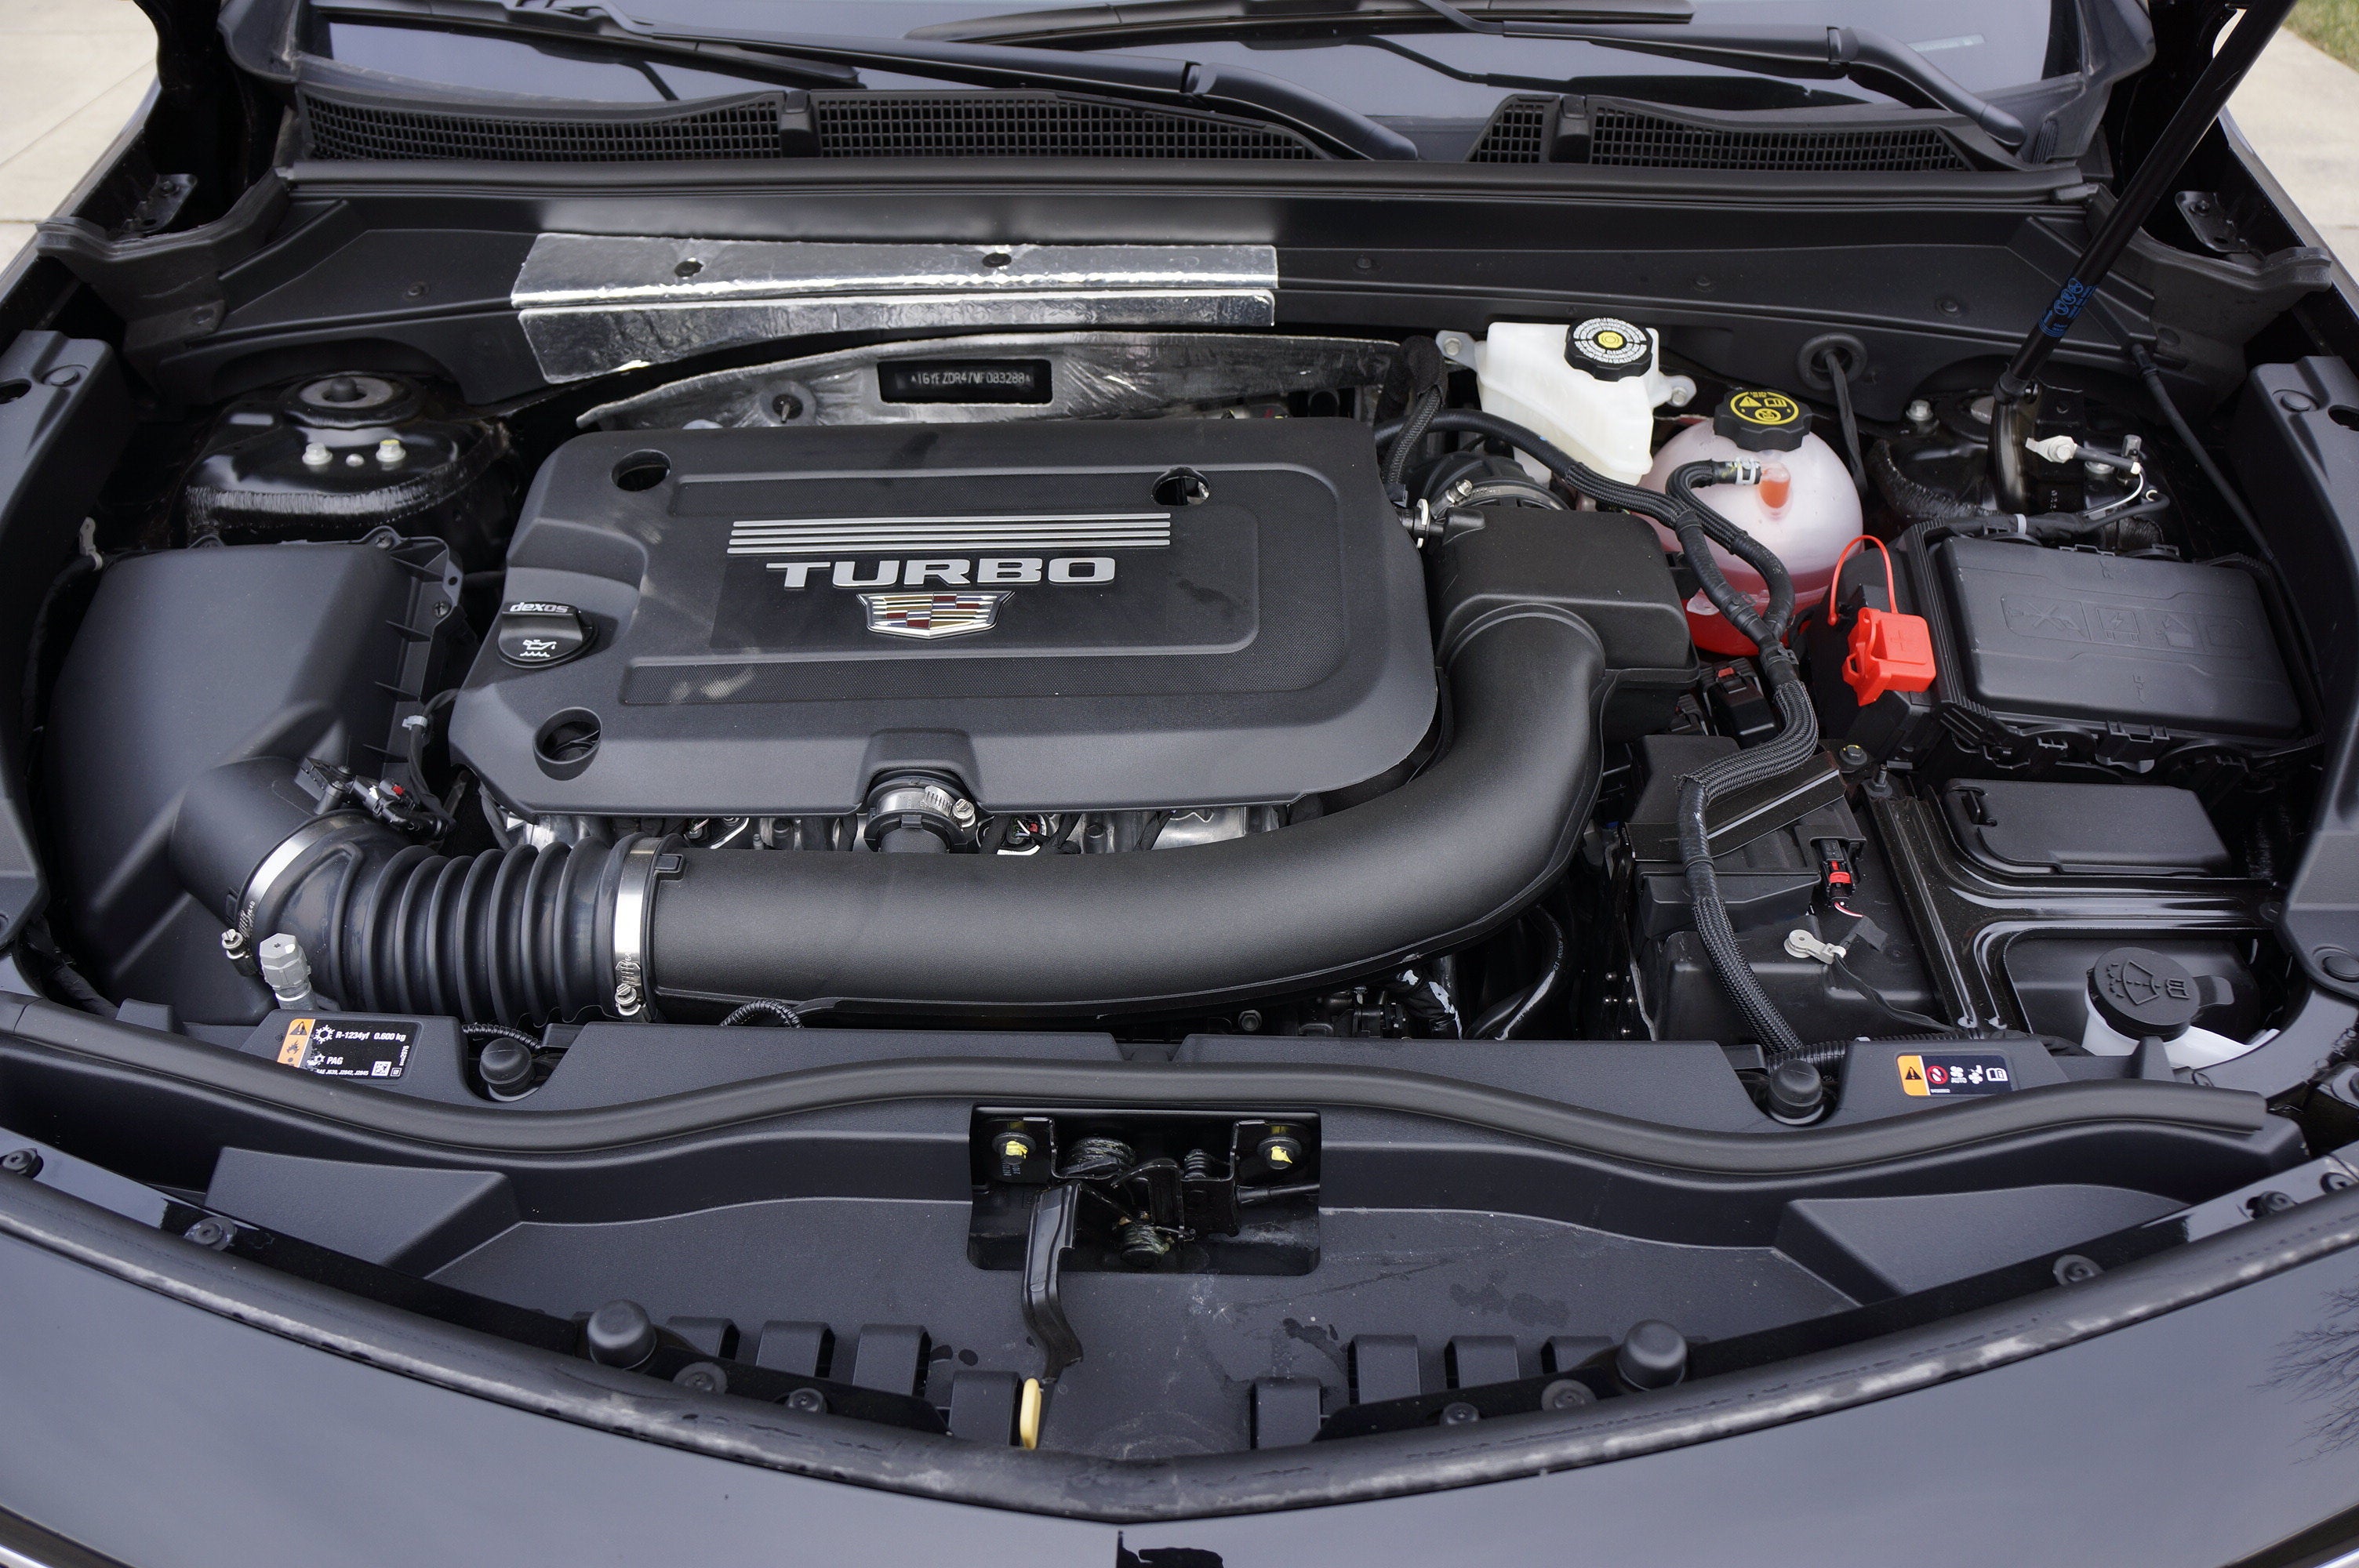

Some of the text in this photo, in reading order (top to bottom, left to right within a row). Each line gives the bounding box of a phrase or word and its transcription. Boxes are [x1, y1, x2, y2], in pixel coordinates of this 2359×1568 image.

[766, 557, 1115, 588] TURBO
[510, 602, 569, 613] dexos
[336, 1032, 370, 1040] R-1234yf
